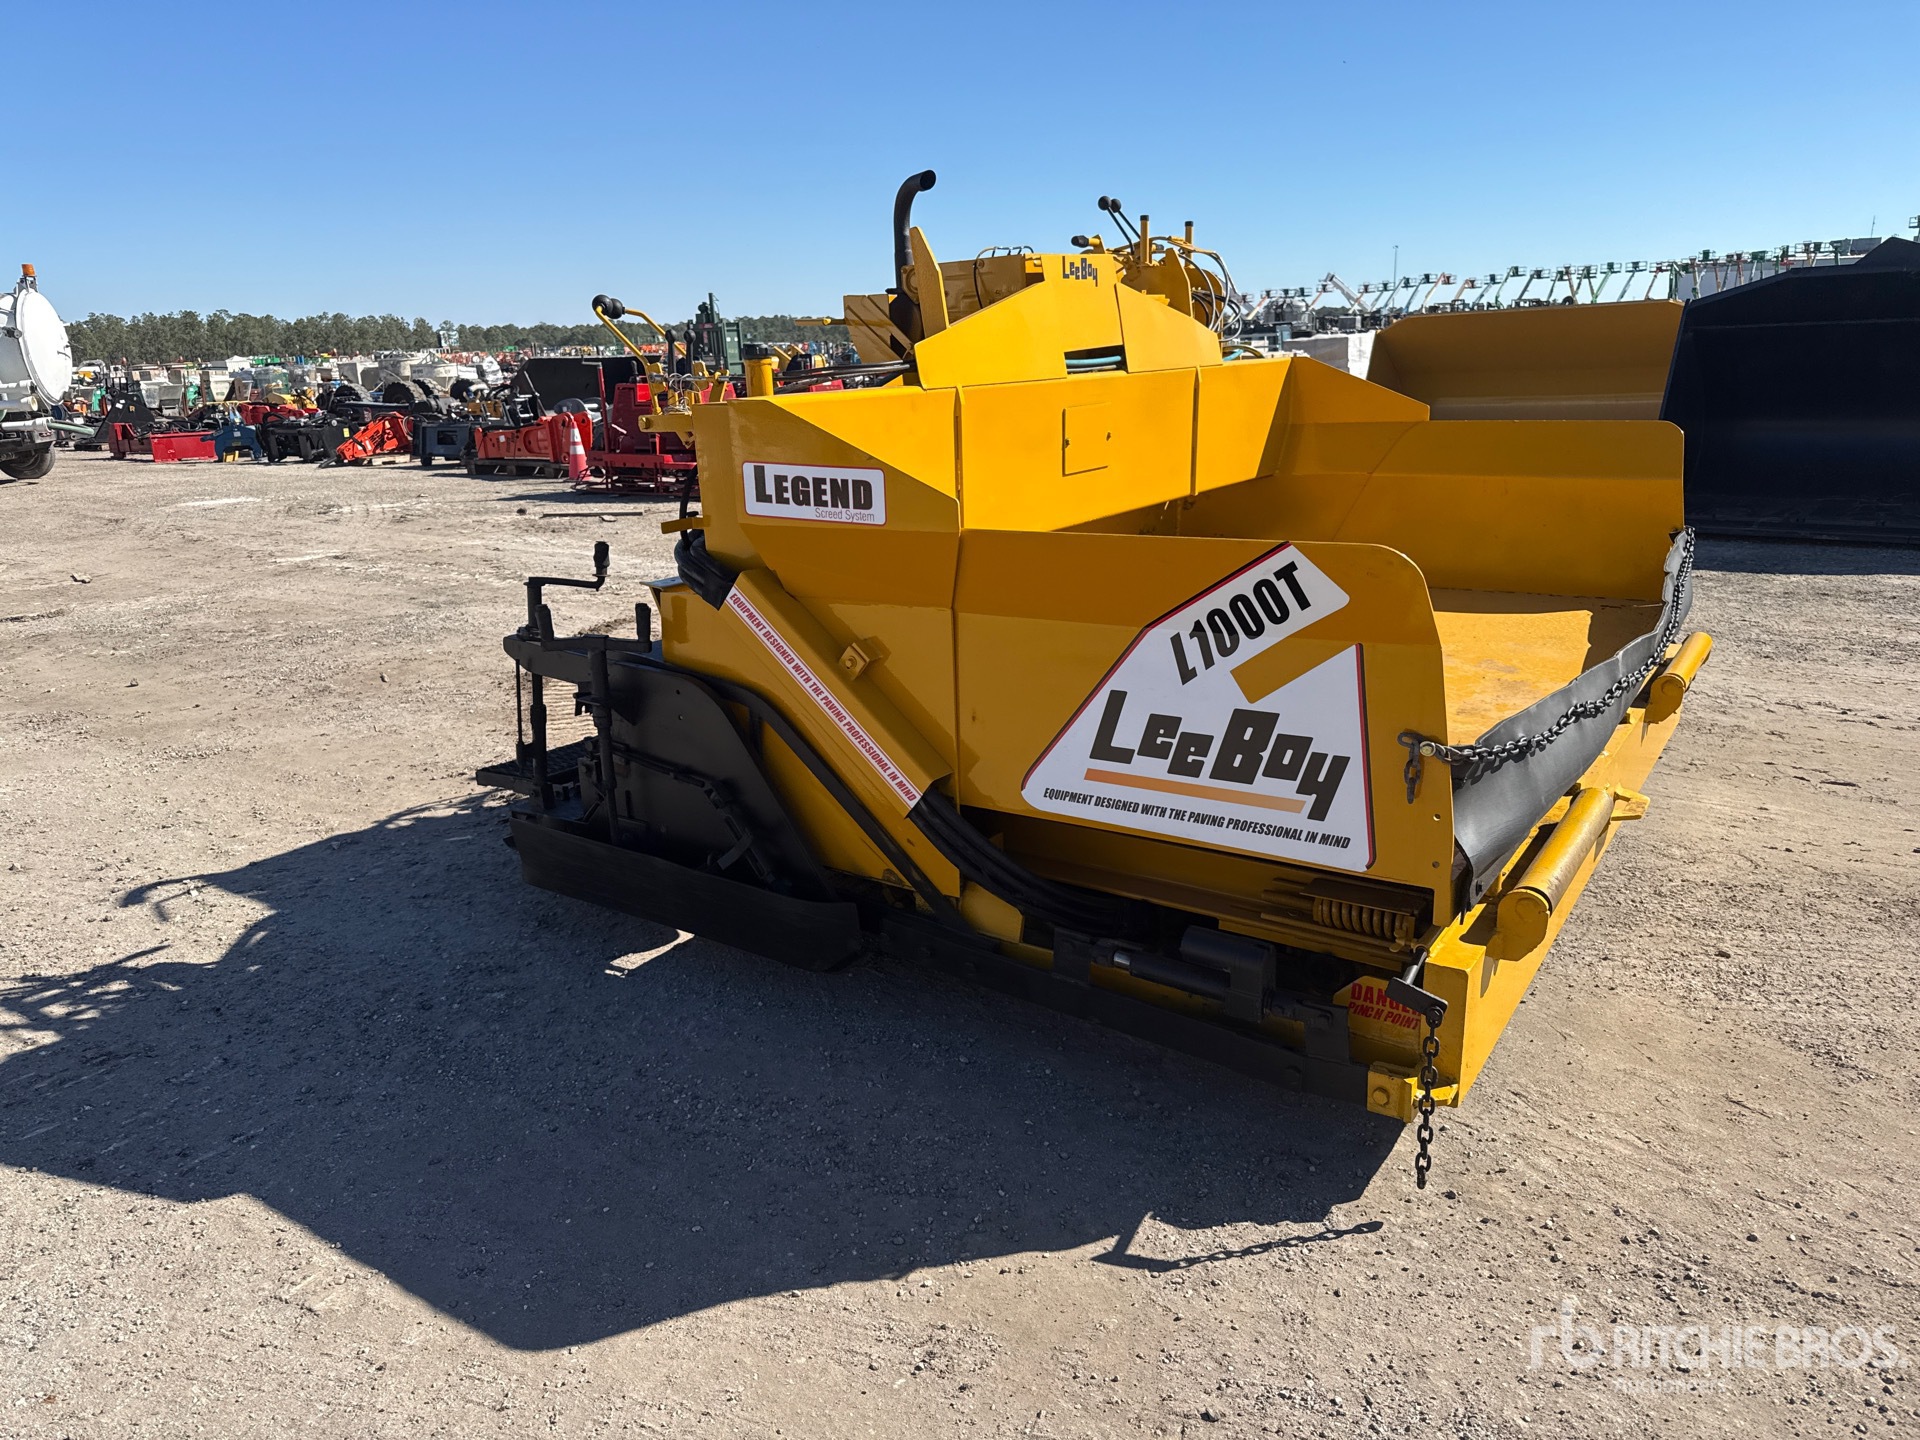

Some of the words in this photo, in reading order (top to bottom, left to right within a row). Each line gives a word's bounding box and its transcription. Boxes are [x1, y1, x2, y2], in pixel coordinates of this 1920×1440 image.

[815, 507, 843, 520] Screed
[845, 509, 875, 523] System
[1170, 561, 1311, 685] L1000T
[729, 593, 767, 632] EQUIPMENT
[762, 630, 796, 665] DESIGNED
[791, 662, 813, 684] WITH
[809, 682, 825, 698] THE
[820, 695, 847, 723] PAVING
[843, 720, 891, 774] PROFESSIONAL
[887, 771, 899, 782] IN
[895, 780, 917, 802] MIND
[1089, 689, 1351, 822] LeeBoy
[1043, 787, 1095, 806] EQUIPMENT
[1093, 795, 1140, 814] DESIGNED
[1140, 803, 1168, 818] WITH
[1168, 808, 1187, 822] THE
[1187, 811, 1226, 828] PAVING
[1225, 817, 1304, 841] PROFESSIONAL
[1304, 830, 1319, 844] IN
[1318, 833, 1351, 849] MIND
[1349, 1001, 1384, 1020] PINCH
[1384, 1011, 1420, 1030] POINT
